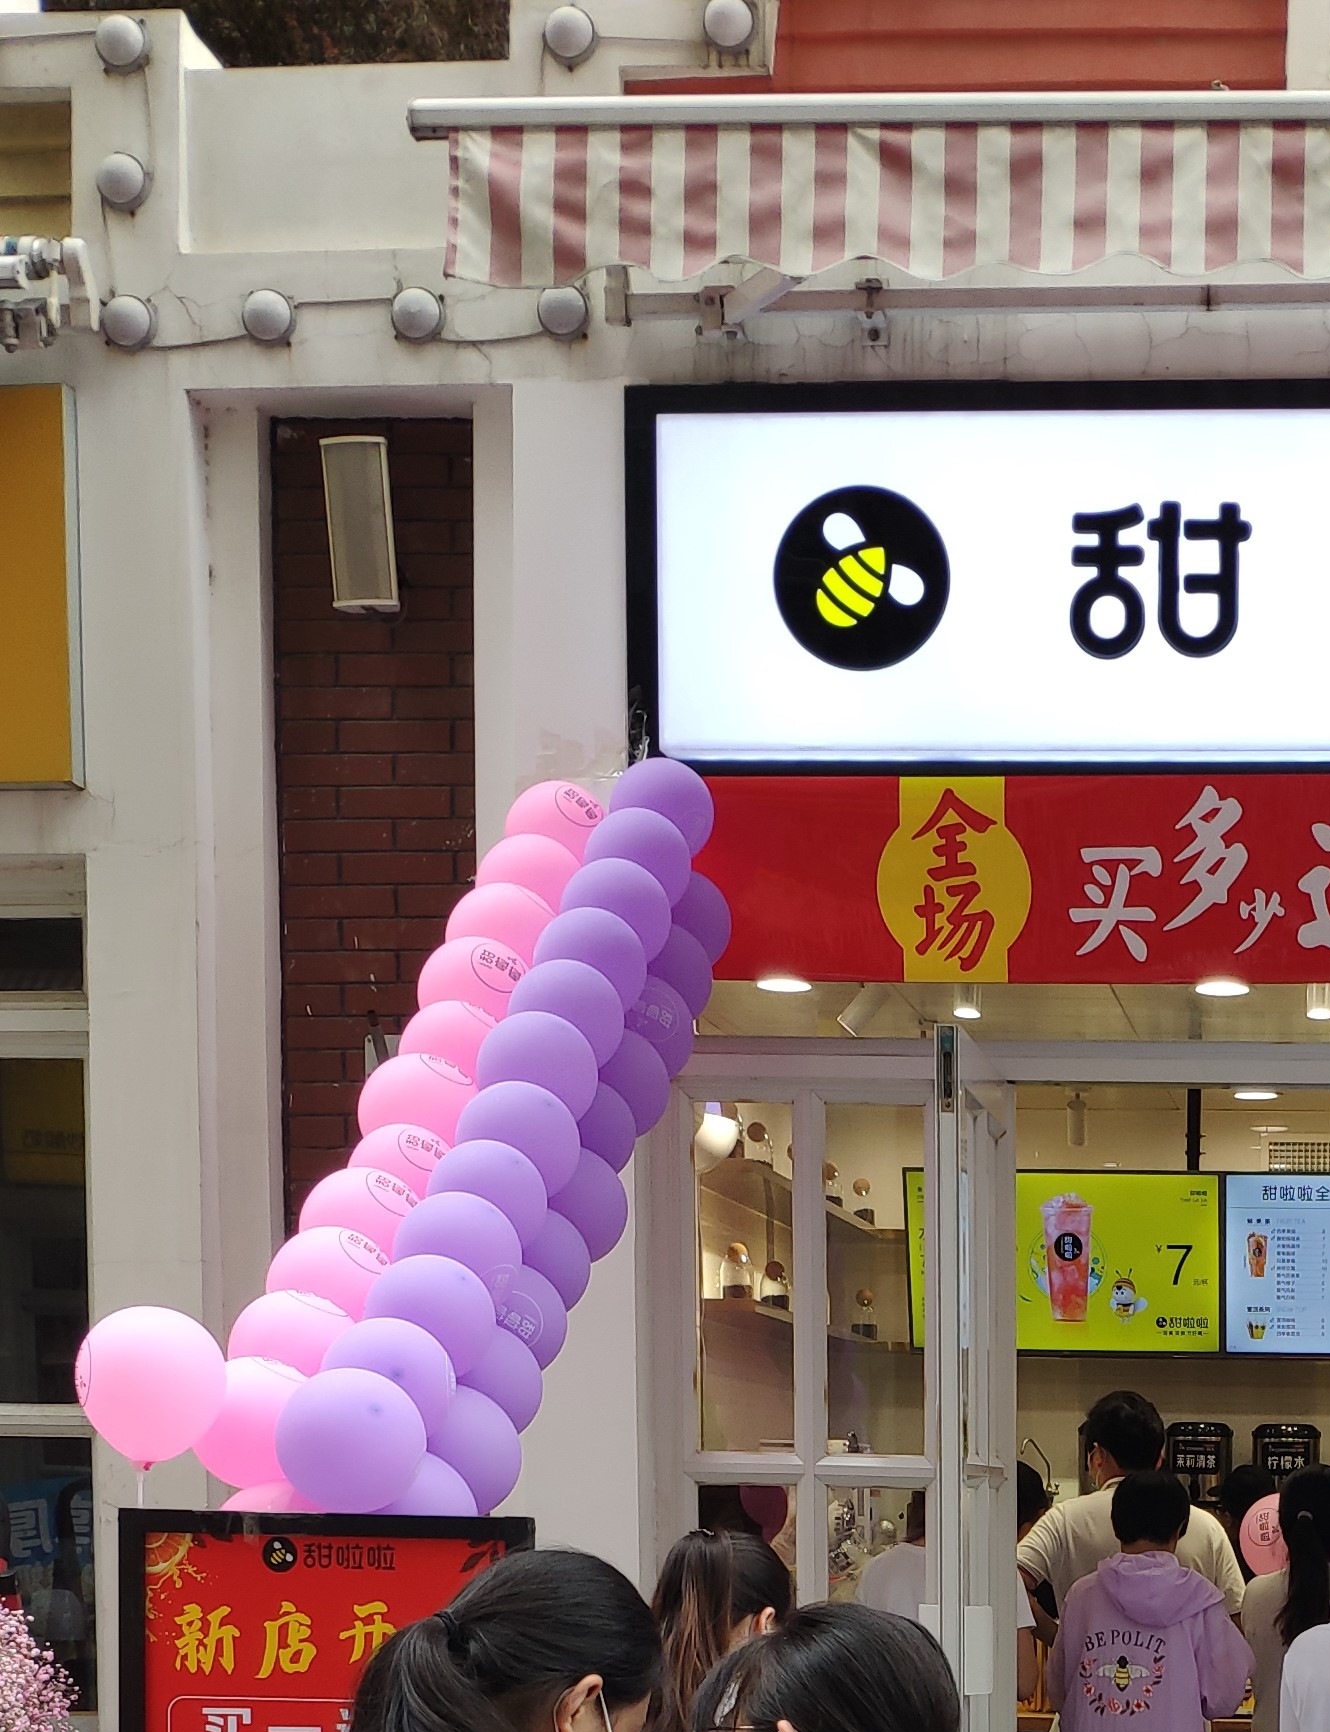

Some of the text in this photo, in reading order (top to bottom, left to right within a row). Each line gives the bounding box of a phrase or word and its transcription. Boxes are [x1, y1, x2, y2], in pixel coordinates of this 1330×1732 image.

[911, 788, 998, 972] 全场
[302, 1542, 396, 1571] 甜啦啦
[1085, 1629, 1166, 1653] BE POLIT
